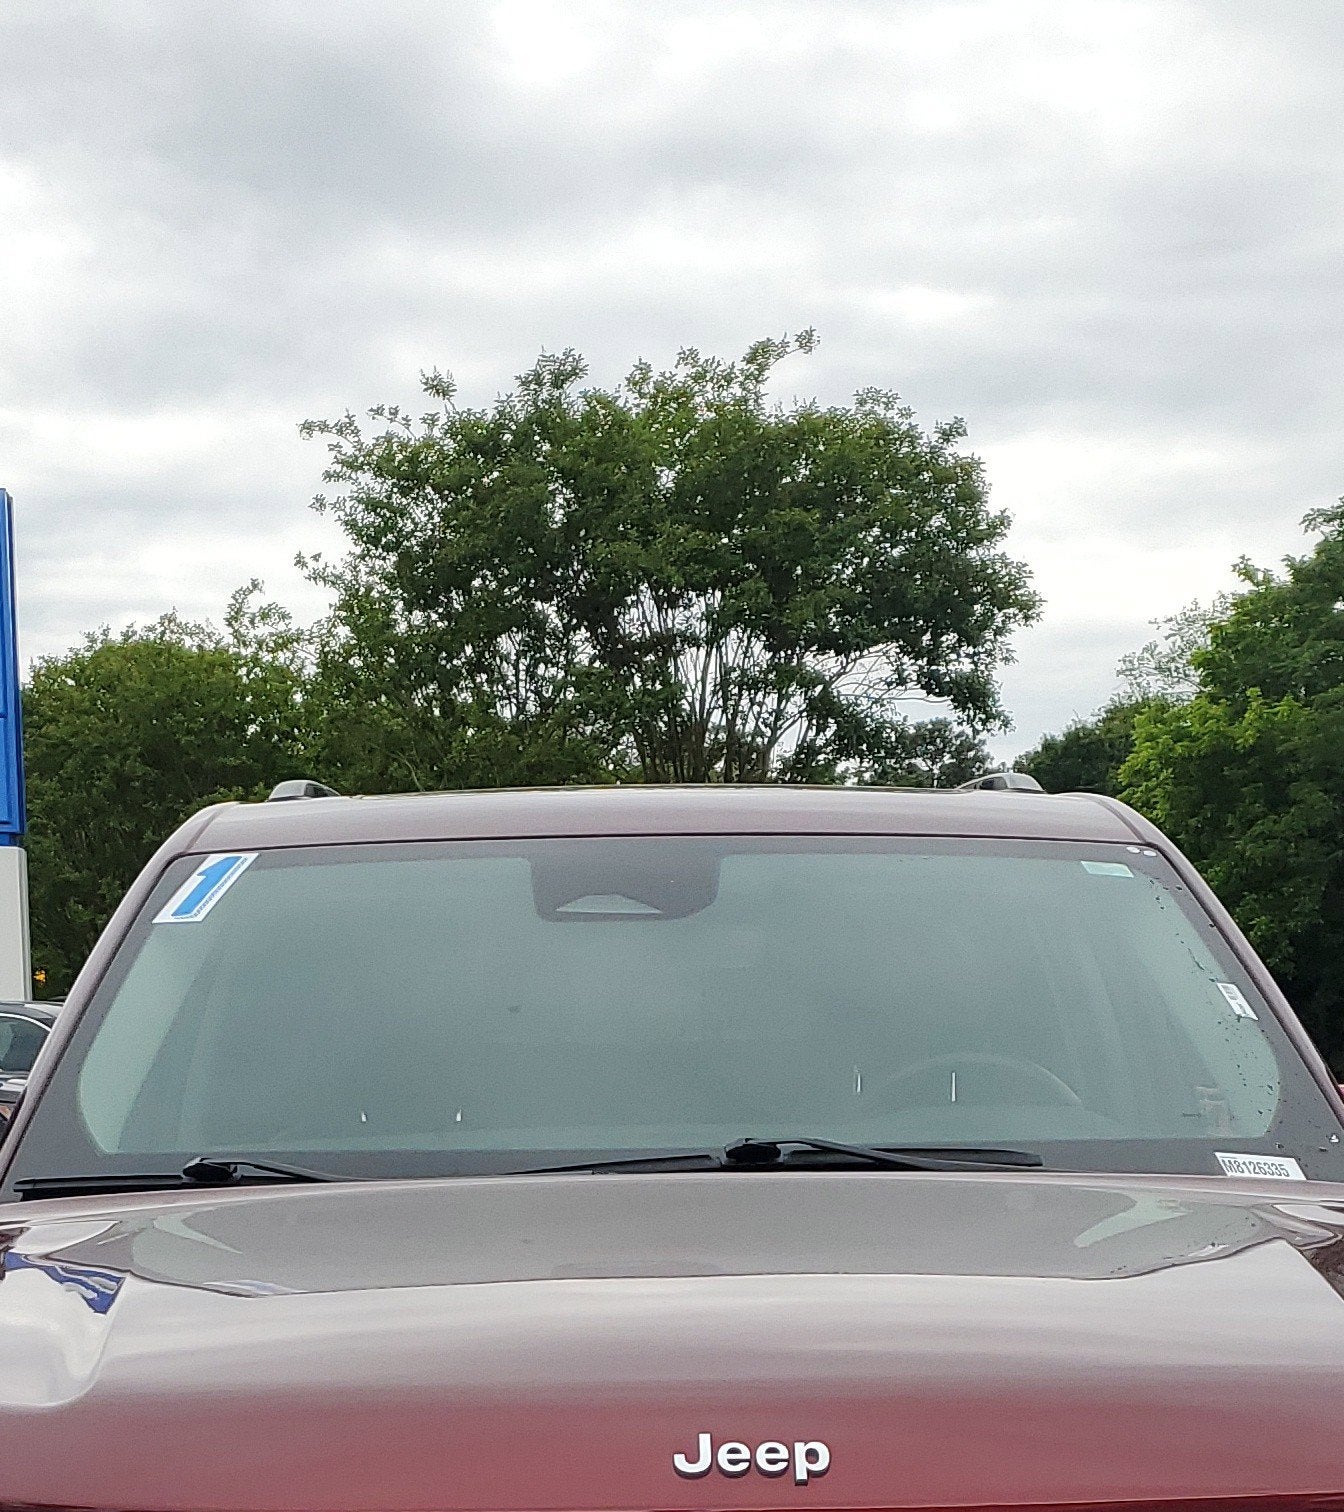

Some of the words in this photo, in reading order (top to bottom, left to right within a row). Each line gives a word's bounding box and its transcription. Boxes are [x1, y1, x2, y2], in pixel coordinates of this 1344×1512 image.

[171, 856, 243, 917] 1
[1221, 1159, 1291, 1178] M8126335
[672, 1431, 831, 1487] Jeep
